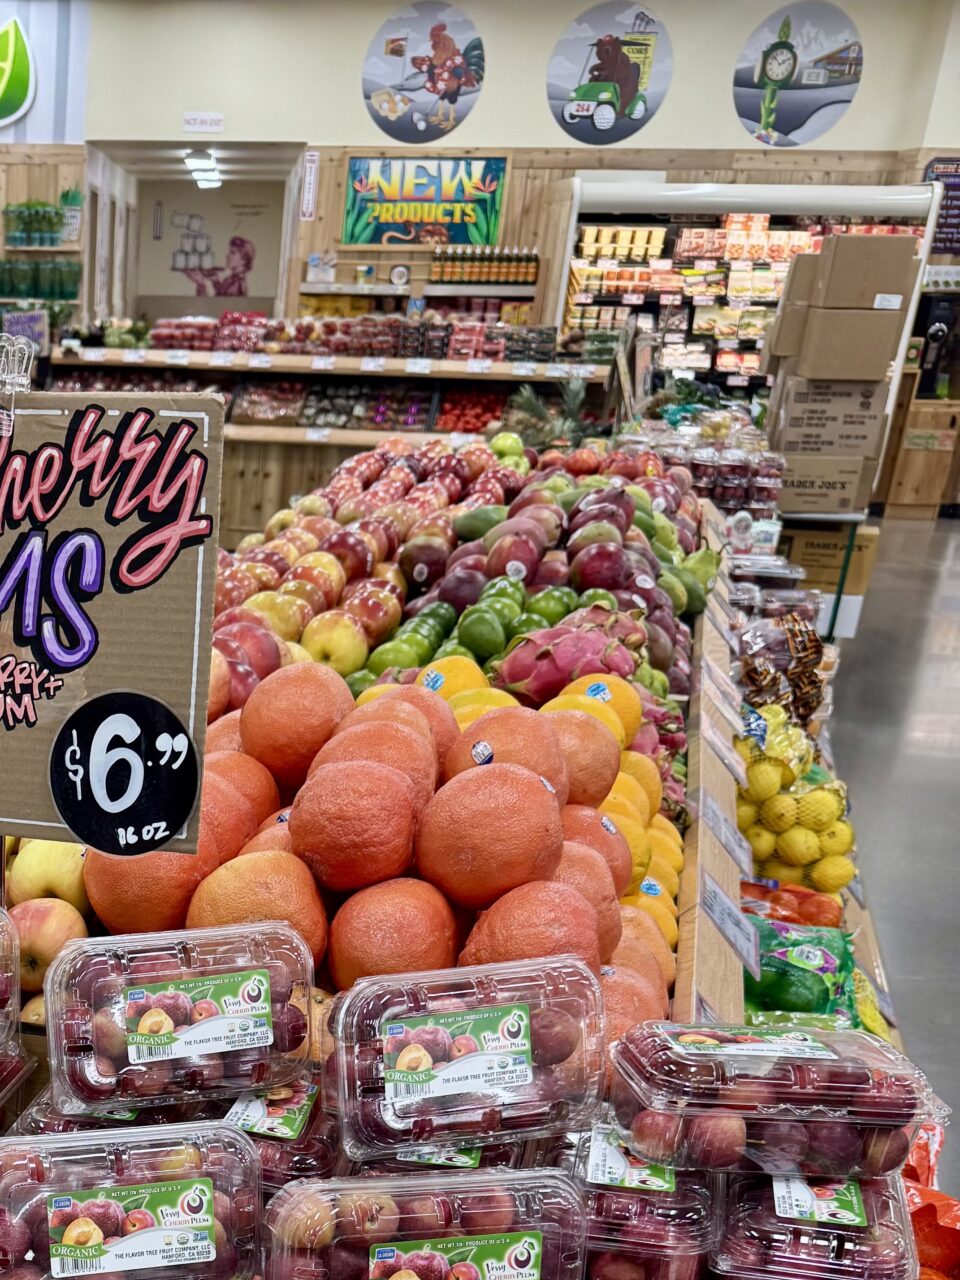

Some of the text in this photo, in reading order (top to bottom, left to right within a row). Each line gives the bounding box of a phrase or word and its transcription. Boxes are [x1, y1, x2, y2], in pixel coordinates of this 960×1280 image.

[368, 160, 486, 200] NEW
[367, 202, 477, 223] PRODUCTS
[142, 821, 169, 840] OZ
[129, 1034, 170, 1044] ORGANIC
[387, 1071, 429, 1081] ORGANIC
[53, 1245, 99, 1256] ORGANIC
